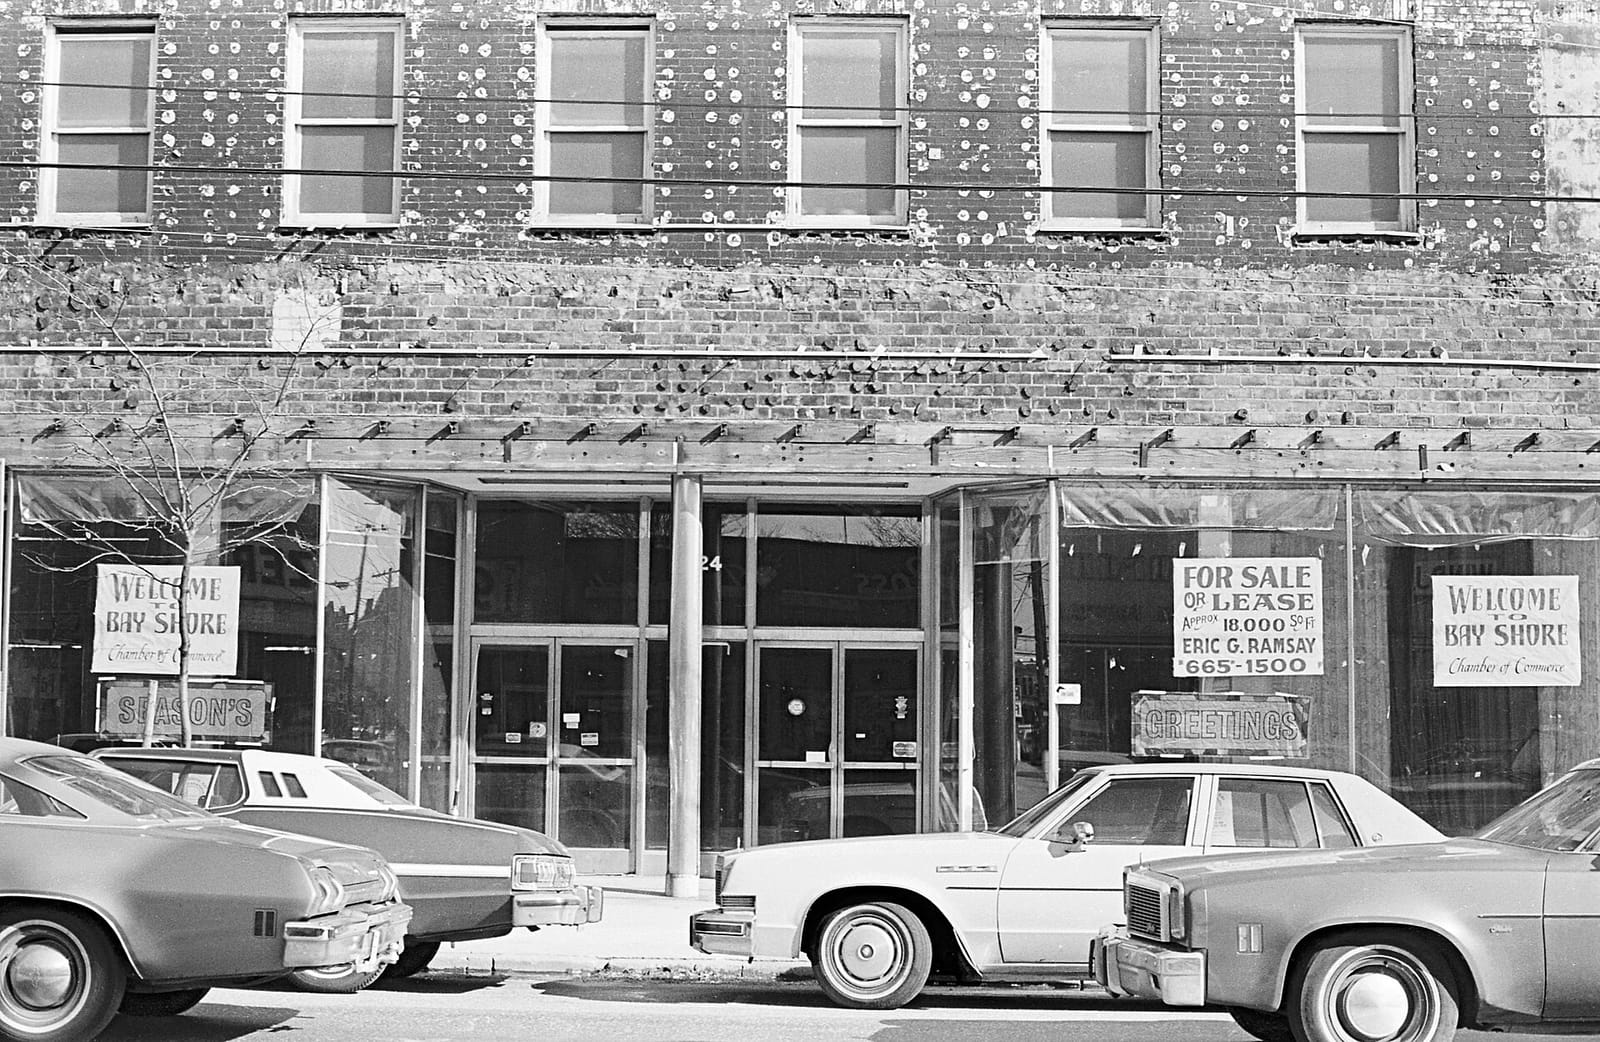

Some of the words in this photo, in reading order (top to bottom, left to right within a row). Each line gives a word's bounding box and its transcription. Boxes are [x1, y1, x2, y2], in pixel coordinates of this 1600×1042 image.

[111, 573, 221, 603] WELCOME
[1183, 566, 1233, 589] FOR
[1241, 566, 1311, 589] SALE
[1184, 592, 1206, 609] OR
[1212, 593, 1314, 611] LEASE
[1446, 585, 1561, 614] WELCOME
[106, 611, 146, 633] BAY
[154, 612, 227, 635] SHORE
[1224, 618, 1286, 632] 18.000
[1488, 613, 1528, 621] TO
[1183, 638, 1220, 654] ERIC
[1227, 638, 1244, 654] G.
[1248, 637, 1316, 654] RAMSAY
[1445, 624, 1485, 647] BAY
[1494, 623, 1569, 647] SHORE
[108, 643, 156, 661] Chamber
[157, 648, 171, 663] of
[172, 647, 223, 662] Cmmerce
[1448, 655, 1496, 674] Chamber
[1500, 661, 1511, 674] of
[1514, 656, 1566, 674] Commerce
[118, 696, 253, 727] SEASON'S
[1145, 709, 1298, 741] GREETINGS
